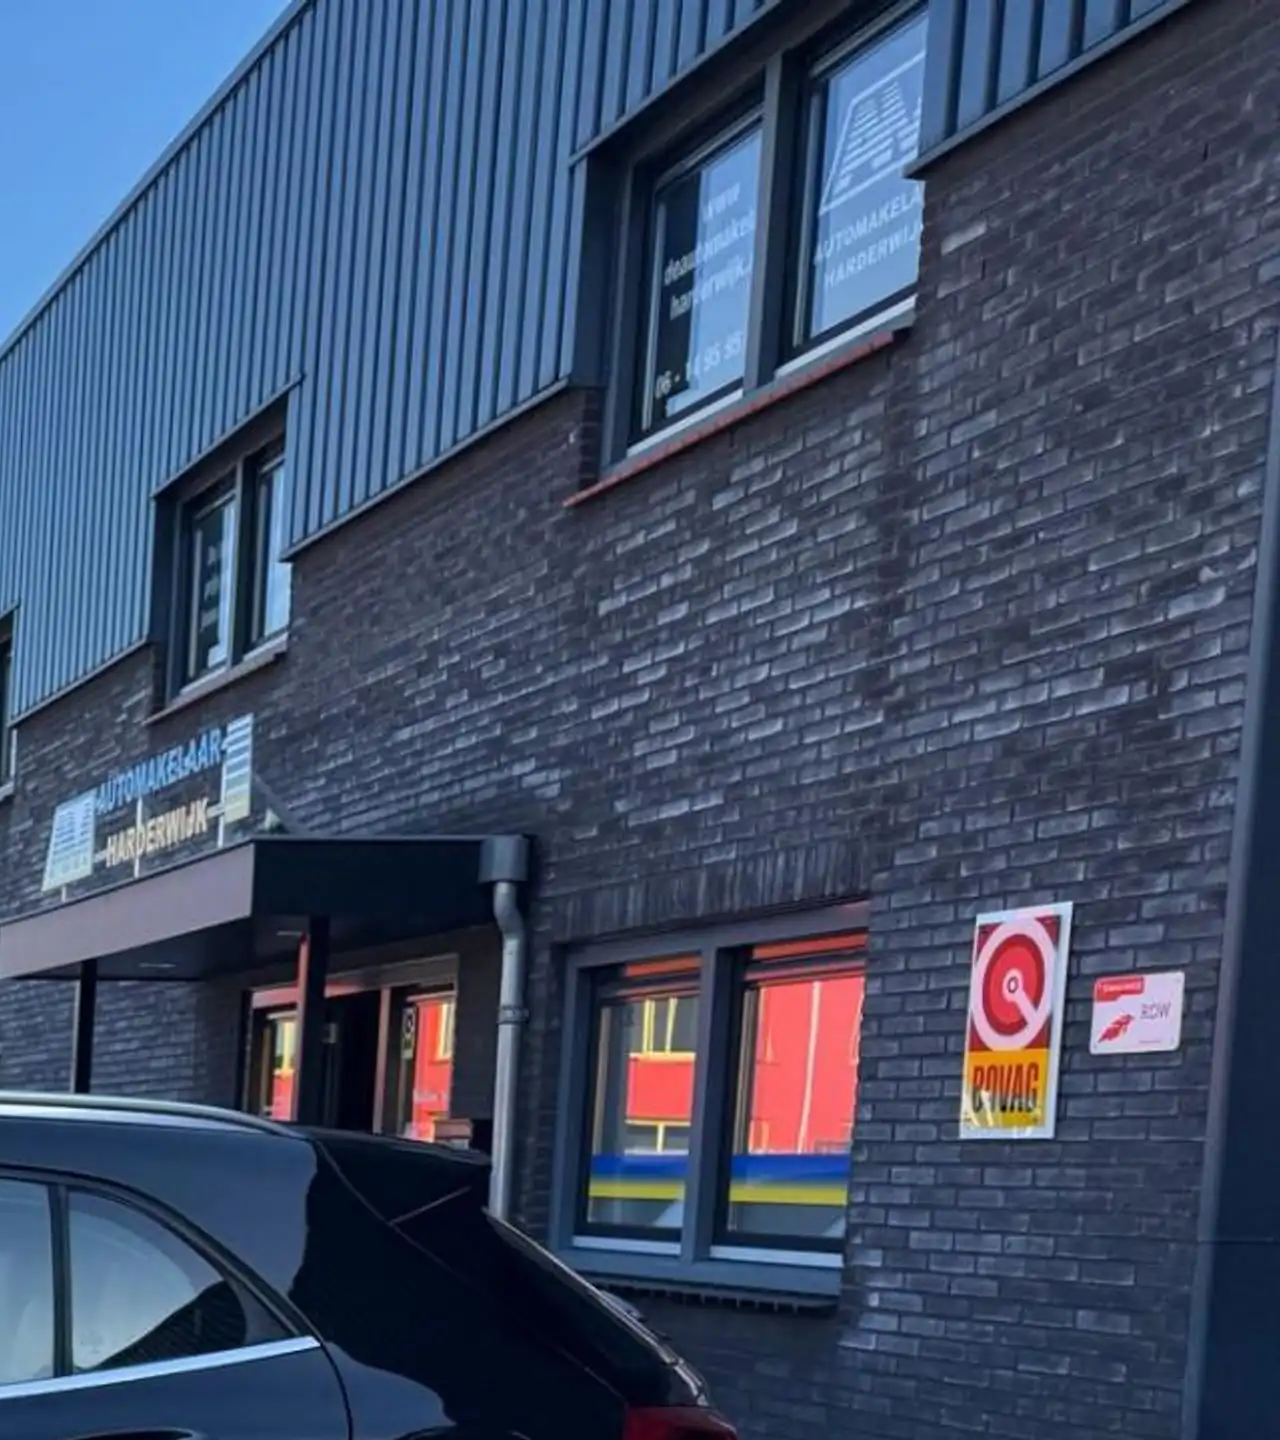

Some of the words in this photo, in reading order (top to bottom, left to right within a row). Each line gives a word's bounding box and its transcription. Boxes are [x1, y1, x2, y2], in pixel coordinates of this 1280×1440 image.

[824, 218, 923, 290] HARDERWIJ
[96, 727, 223, 815] AUTOMAKELAAR
[105, 797, 209, 868] HARDERWIJK
[972, 1062, 1040, 1113] BOVAG
